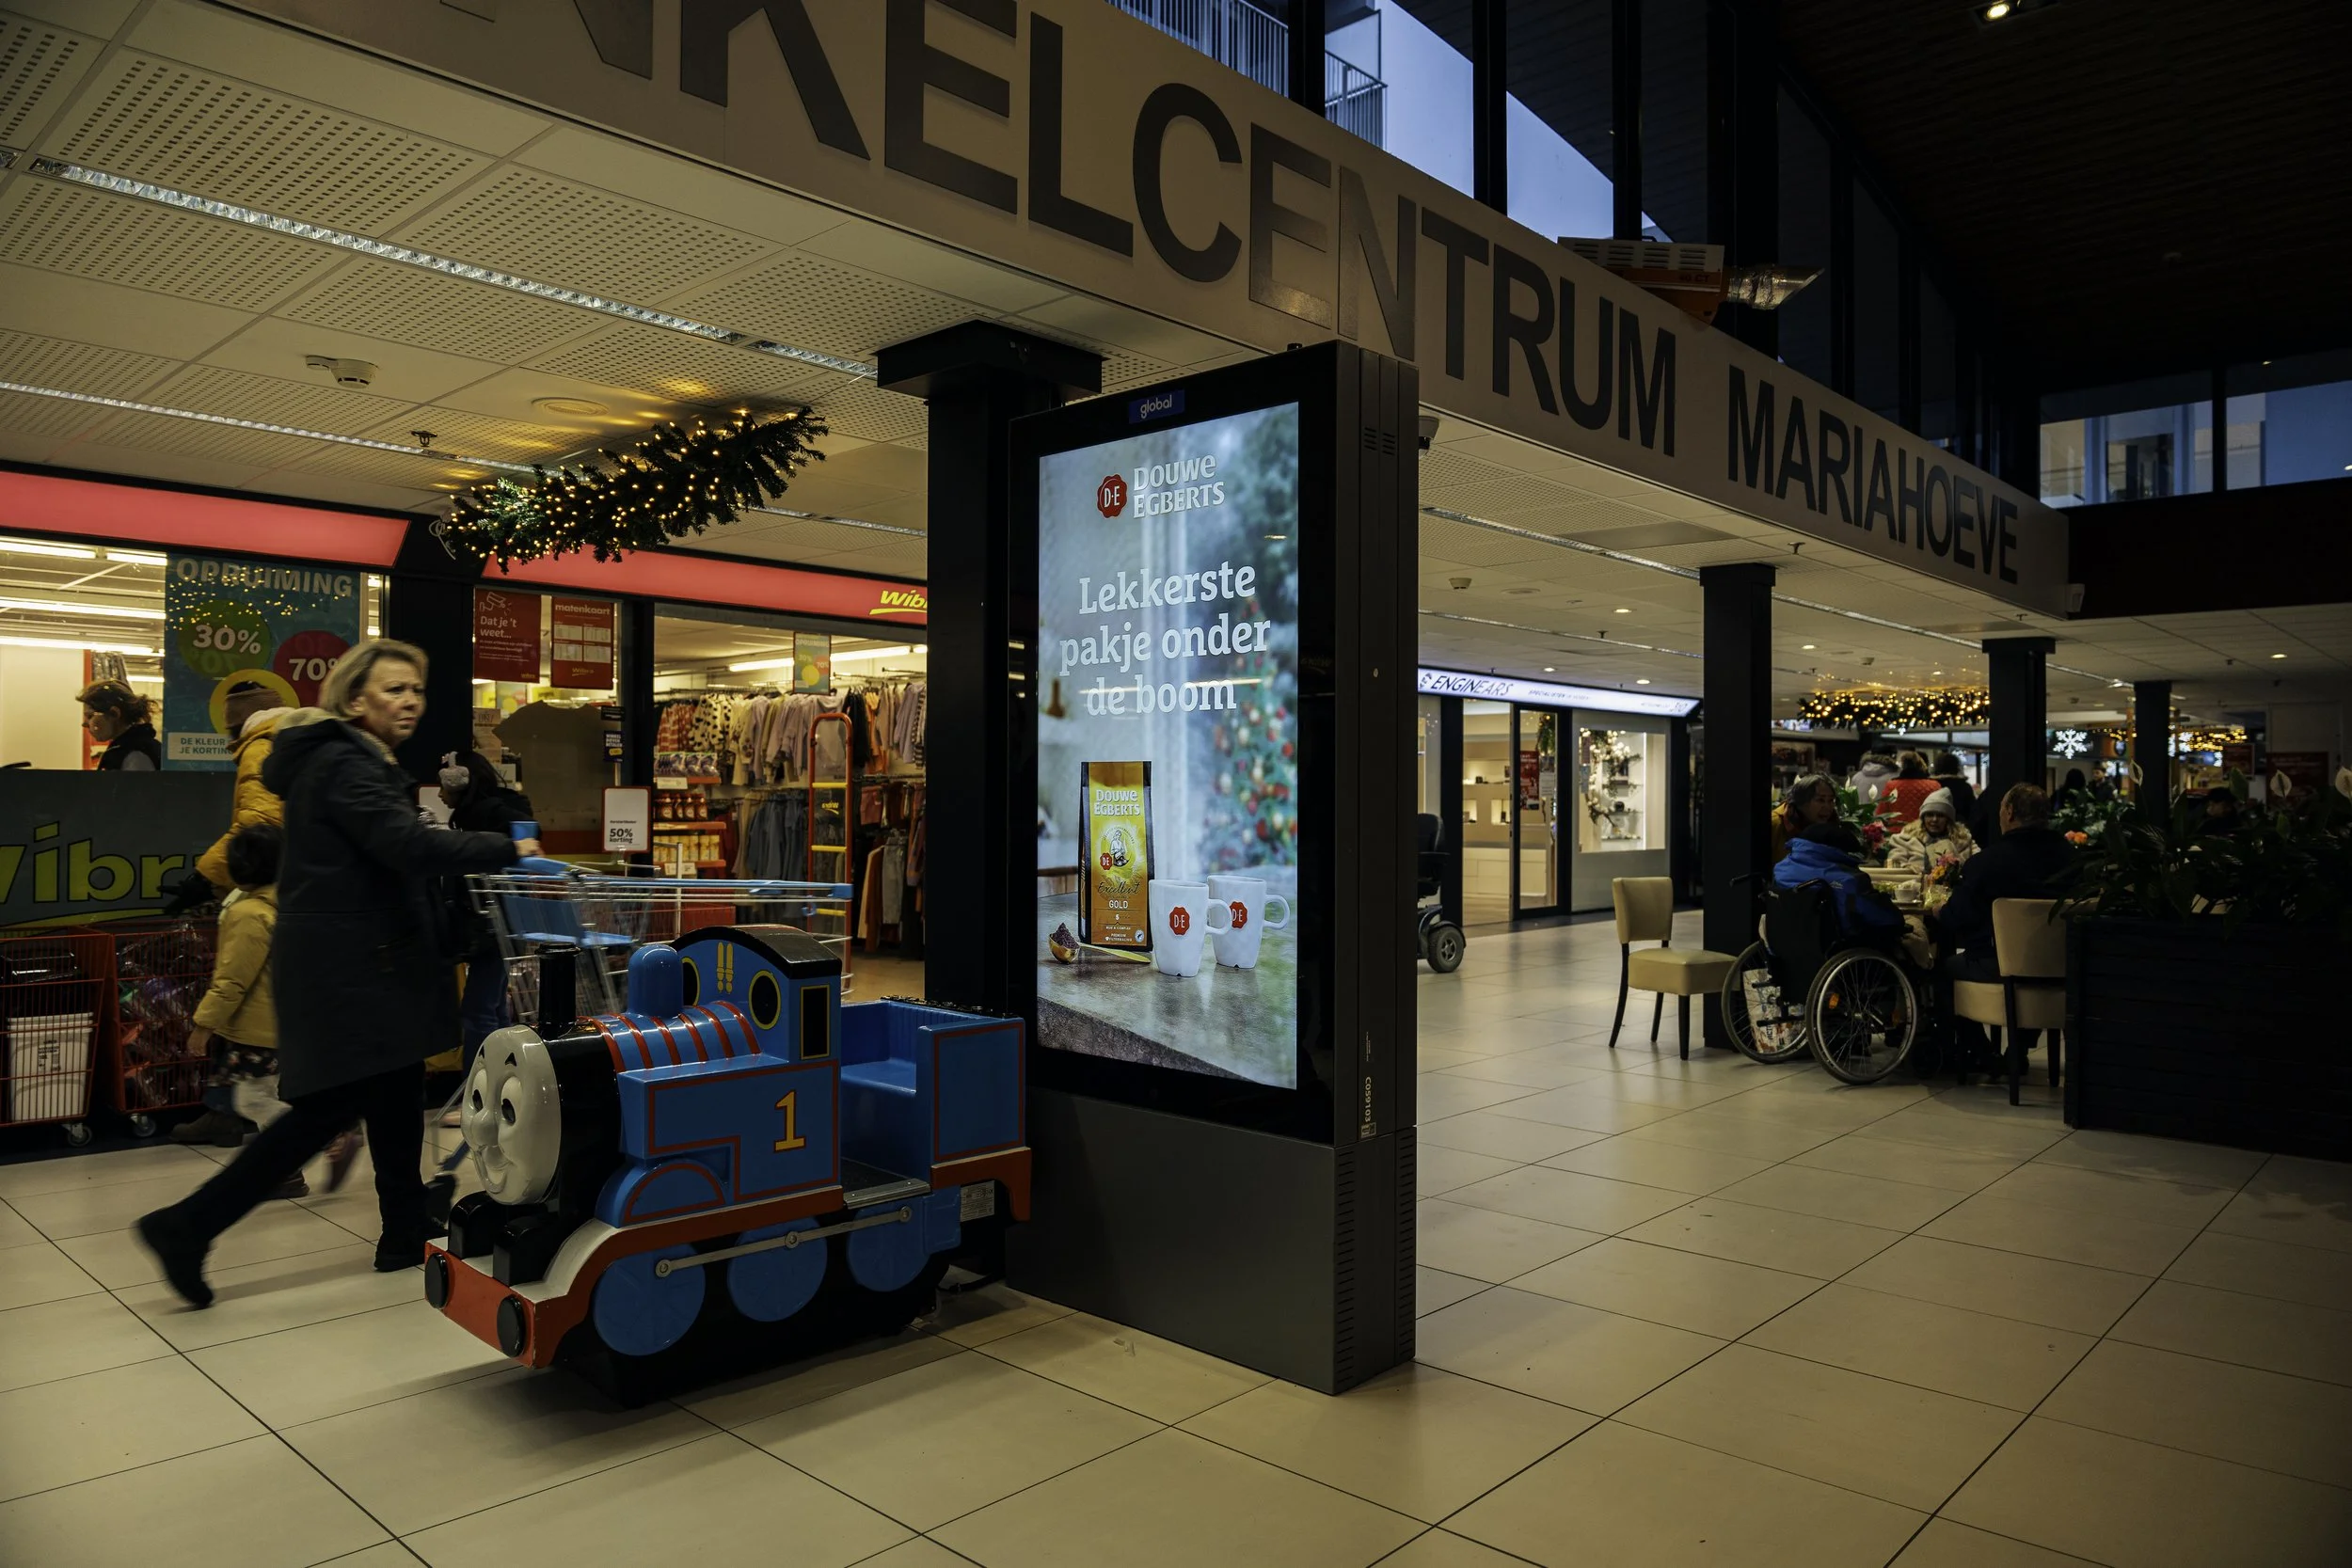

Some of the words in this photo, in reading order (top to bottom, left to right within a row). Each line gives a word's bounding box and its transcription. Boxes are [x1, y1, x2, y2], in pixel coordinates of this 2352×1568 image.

[1139, 394, 1173, 419] global
[1727, 363, 2020, 586] MARIAHOEVE
[1132, 481, 1225, 519] EGBERTS
[176, 558, 353, 597] OPRUIMING
[1078, 561, 1256, 615] Lekkerste
[554, 603, 611, 615] matenkaart
[880, 589, 928, 609] Wib
[480, 615, 498, 626] Dat
[499, 617, 508, 628] je
[192, 624, 262, 656] 30%
[1059, 621, 1152, 677] pakje
[1160, 612, 1271, 660] onder
[1087, 676, 1125, 717] de
[1135, 673, 1237, 714] boom
[1430, 674, 1514, 697] ENGINEARS
[180, 746, 190, 754] JE
[195, 737, 226, 746] KLEUR
[1093, 801, 1141, 816] EGBERTS
[609, 828, 633, 838] 50%
[609, 836, 633, 845] korting
[0, 820, 203, 905] ibr
[1097, 879, 1141, 897] Excellent
[1108, 899, 1129, 909] GOLD
[773, 1088, 806, 1153] 1
